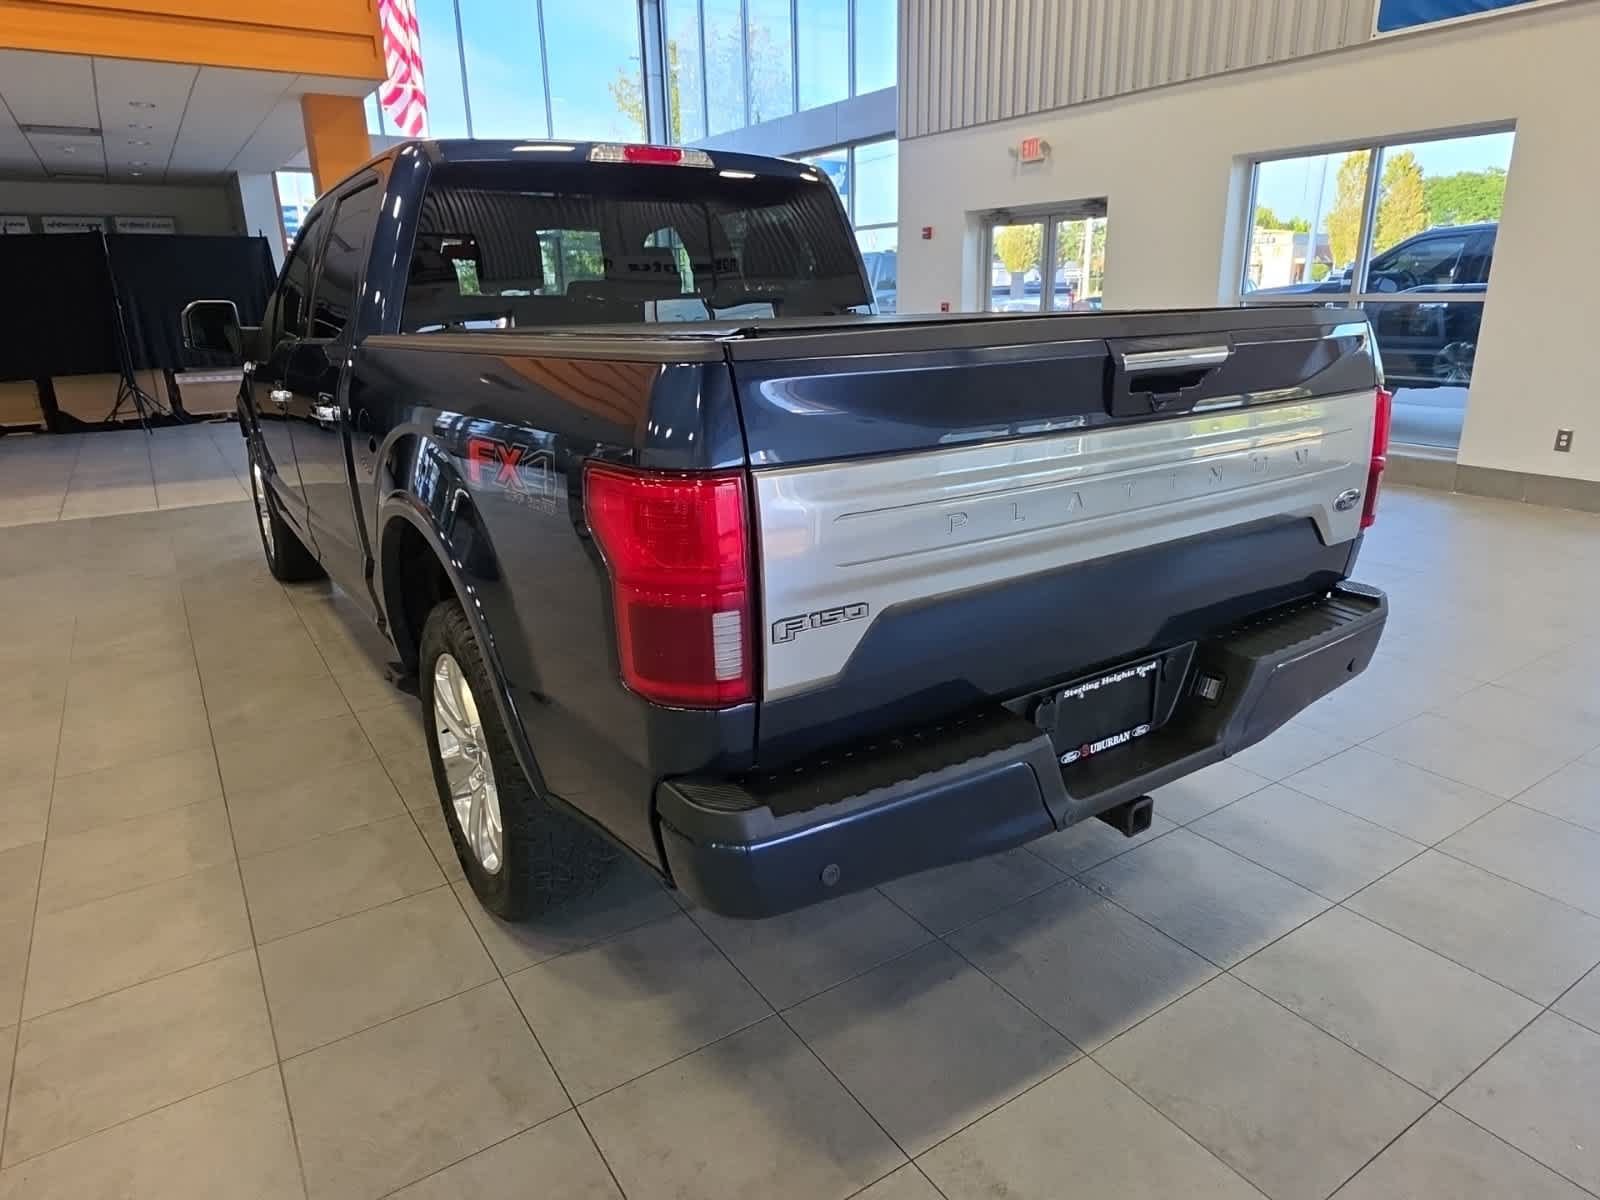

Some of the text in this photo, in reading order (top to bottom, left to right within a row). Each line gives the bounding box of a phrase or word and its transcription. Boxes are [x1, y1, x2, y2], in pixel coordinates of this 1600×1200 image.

[466, 435, 557, 505] FX4
[945, 449, 1309, 534] PLATINUM
[1101, 669, 1135, 686] Heights
[1081, 731, 1131, 757] SUBURBAN
